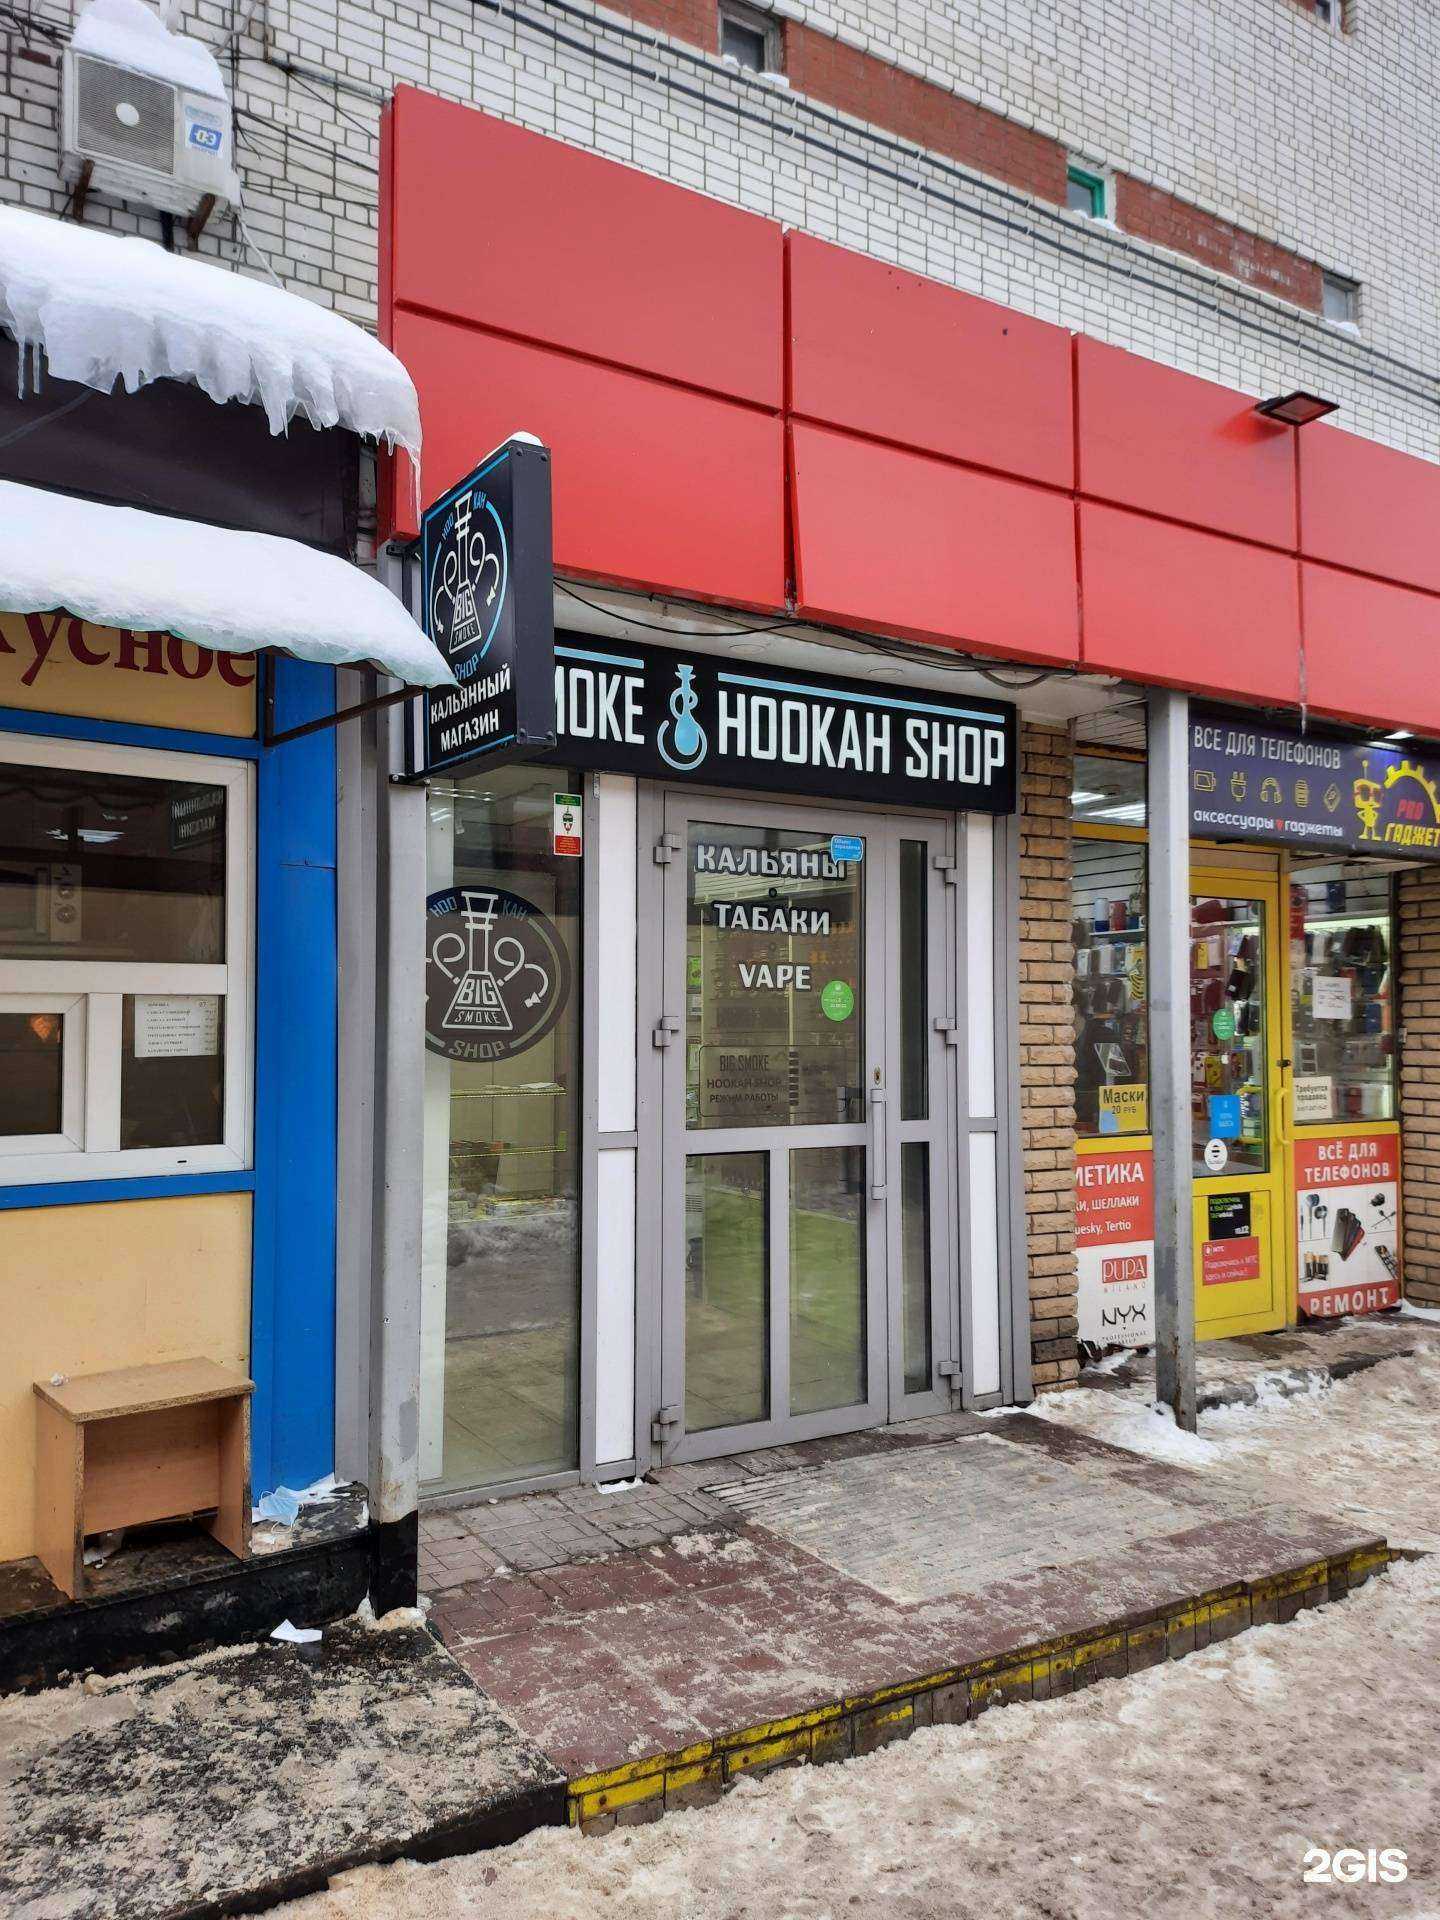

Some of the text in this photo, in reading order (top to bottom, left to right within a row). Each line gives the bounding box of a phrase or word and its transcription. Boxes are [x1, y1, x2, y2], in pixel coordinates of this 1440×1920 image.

[454, 589, 474, 624] BIG
[454, 623, 476, 645] SMOKE
[454, 653, 479, 680] SHOP
[431, 663, 511, 724] КАЛЬЯННЫЙ
[440, 709, 499, 752] МАГАЗИН
[718, 690, 891, 775] HOOKAH
[905, 718, 1005, 786] SHOP
[1194, 725, 1342, 770] ВСЕ ДЛЯ ТЕЛЕФОНОВ
[1193, 809, 1344, 838] аксессуары гаджеты
[696, 844, 846, 879] КАЛЬЯНЫ
[713, 903, 830, 935] ТАБАКИ
[738, 963, 811, 990] VAPE
[457, 978, 497, 1005] BIG
[454, 1010, 501, 1024] SMOKE
[448, 1039, 507, 1059] SHOP
[1103, 1088, 1145, 1104] Маски
[1112, 1105, 1121, 1114] 20
[1318, 1140, 1377, 1161] ВСЁ ДЛЯ
[1304, 1162, 1390, 1183] ТЕЛЕФОНОВ
[1092, 1195, 1140, 1212] ШЕЛЛАКИ
[1103, 1257, 1147, 1282] PUPA
[1309, 1286, 1389, 1316] РЕМОНТ
[1101, 1303, 1146, 1327] NYX
